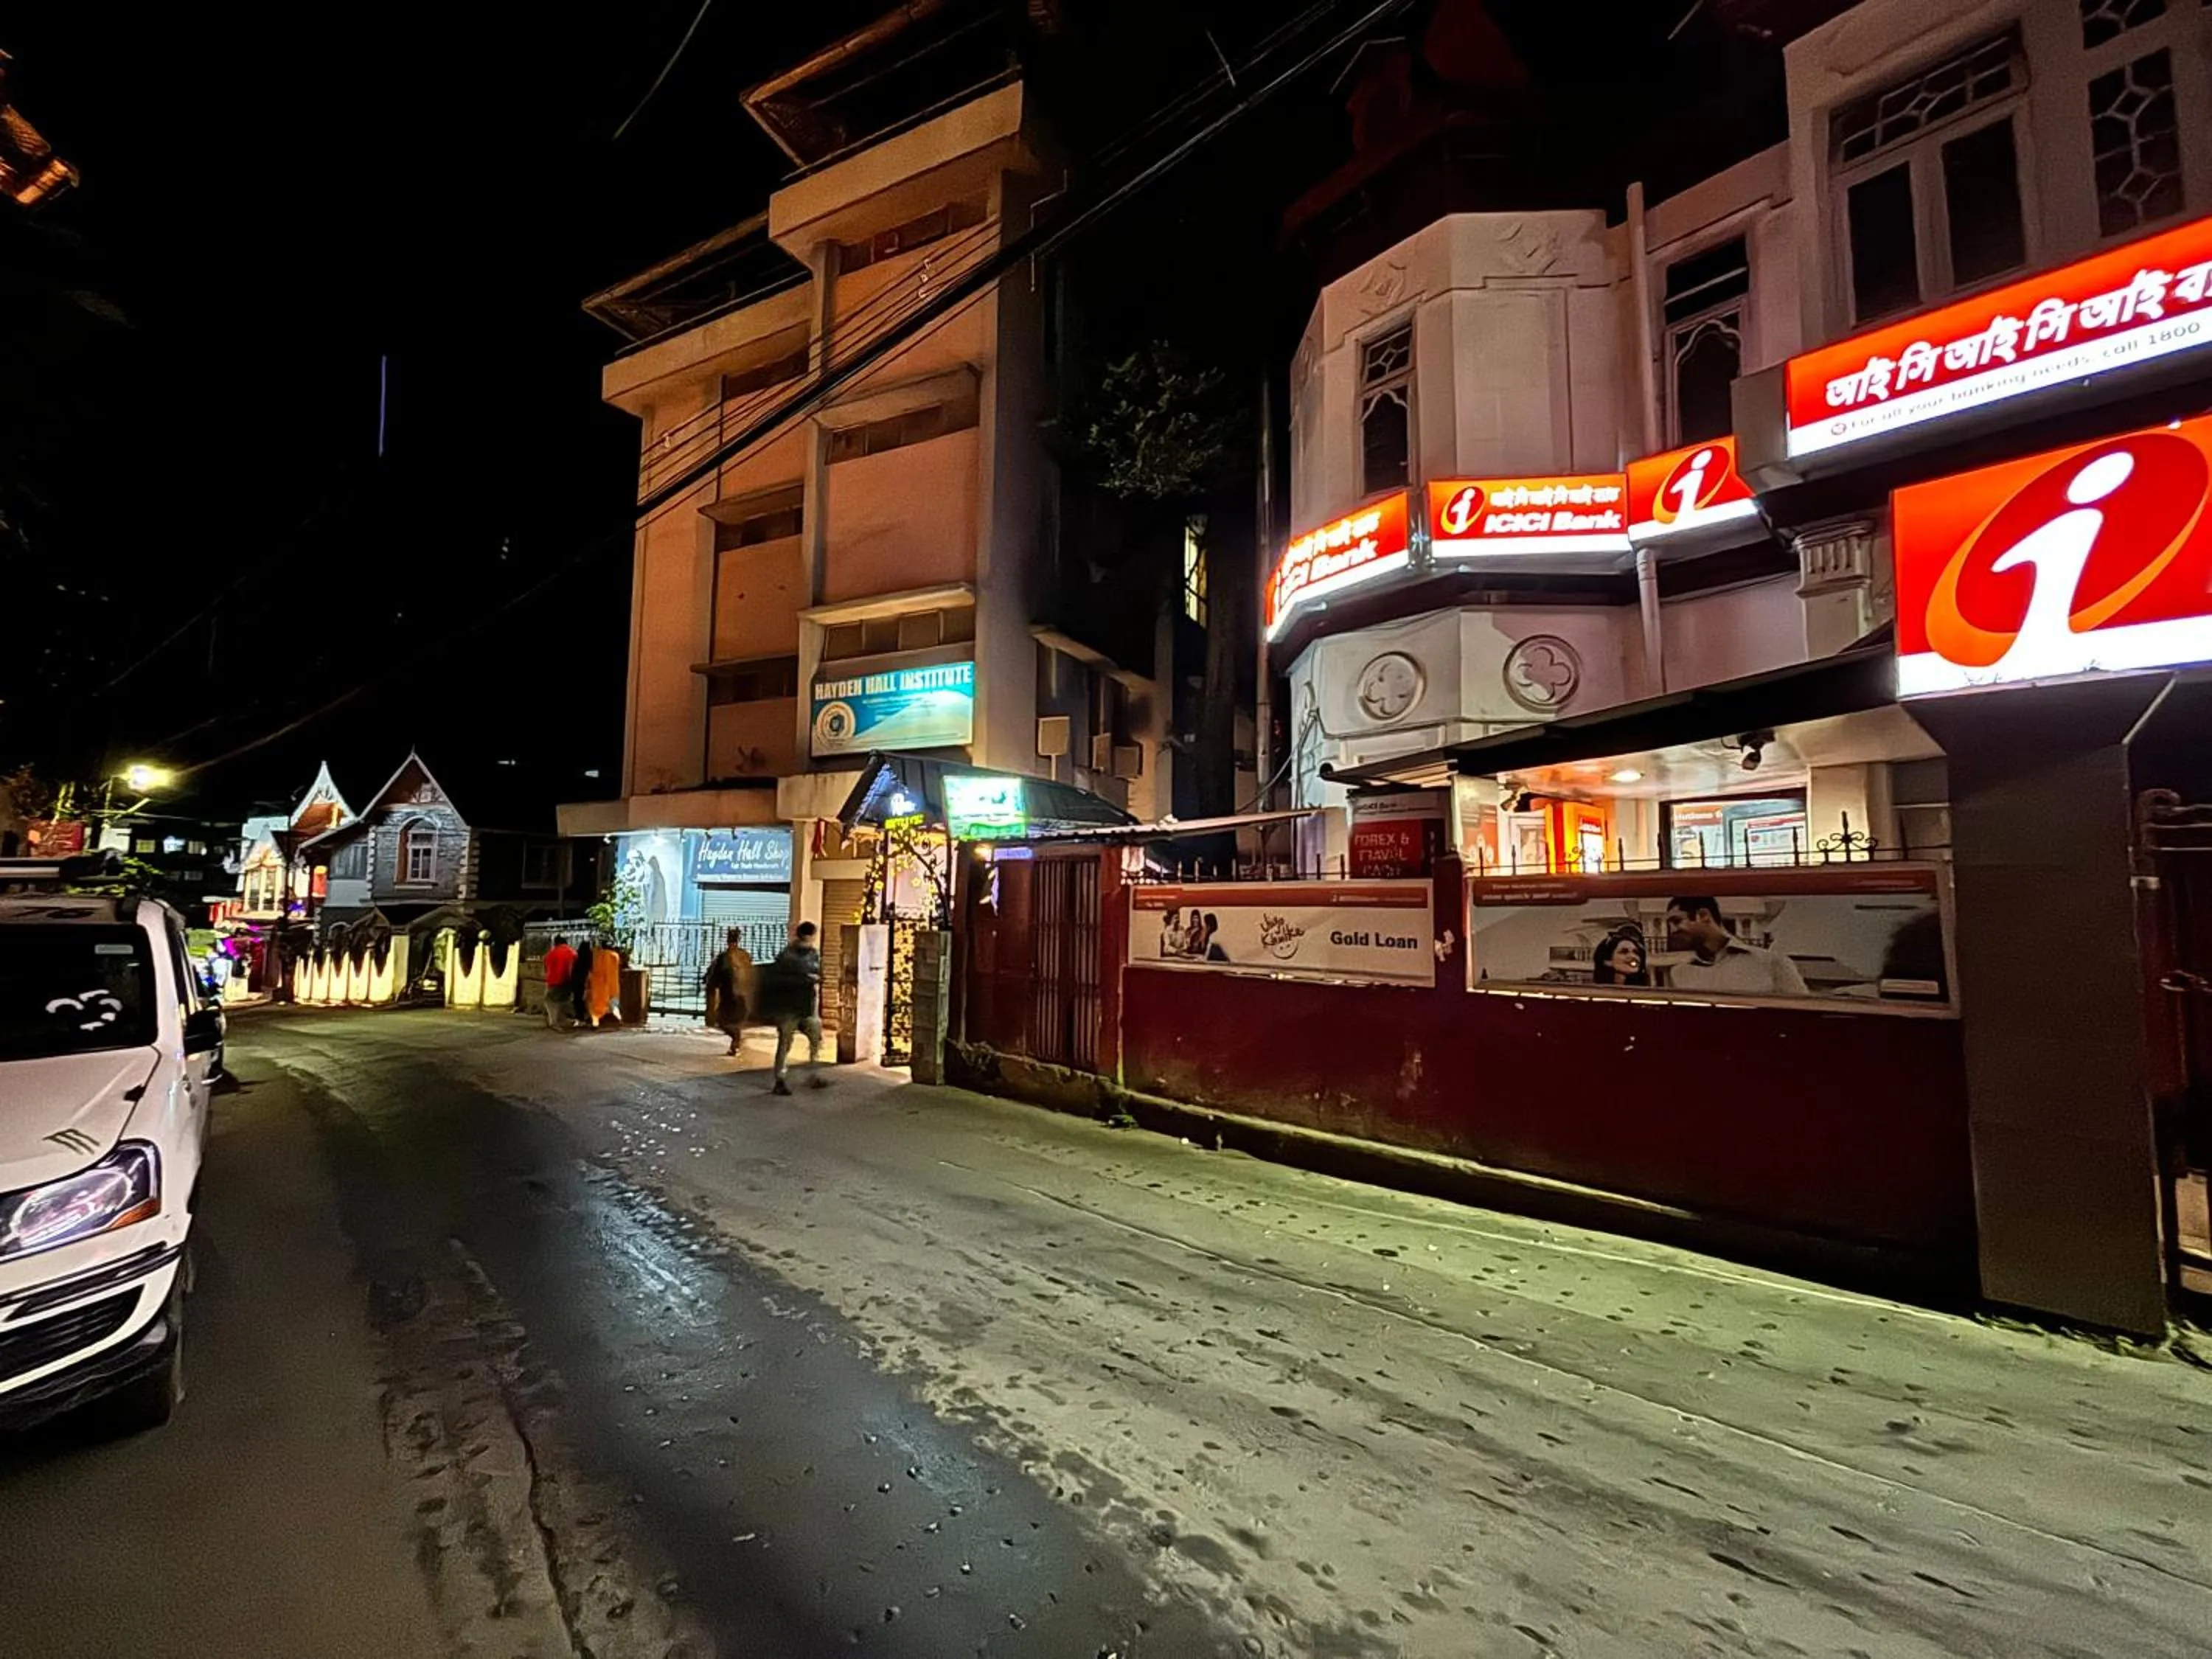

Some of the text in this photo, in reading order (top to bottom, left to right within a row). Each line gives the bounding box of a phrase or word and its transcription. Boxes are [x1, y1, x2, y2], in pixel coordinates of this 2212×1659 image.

[2147, 321, 2201, 346] 1800
[1484, 509, 1622, 534] ICICI Bank
[815, 665, 972, 700] HAYDEN HALL INSTITUTE
[737, 839, 763, 861] Hall
[765, 839, 789, 867] Shop
[1329, 930, 1419, 949] Gold Loan
